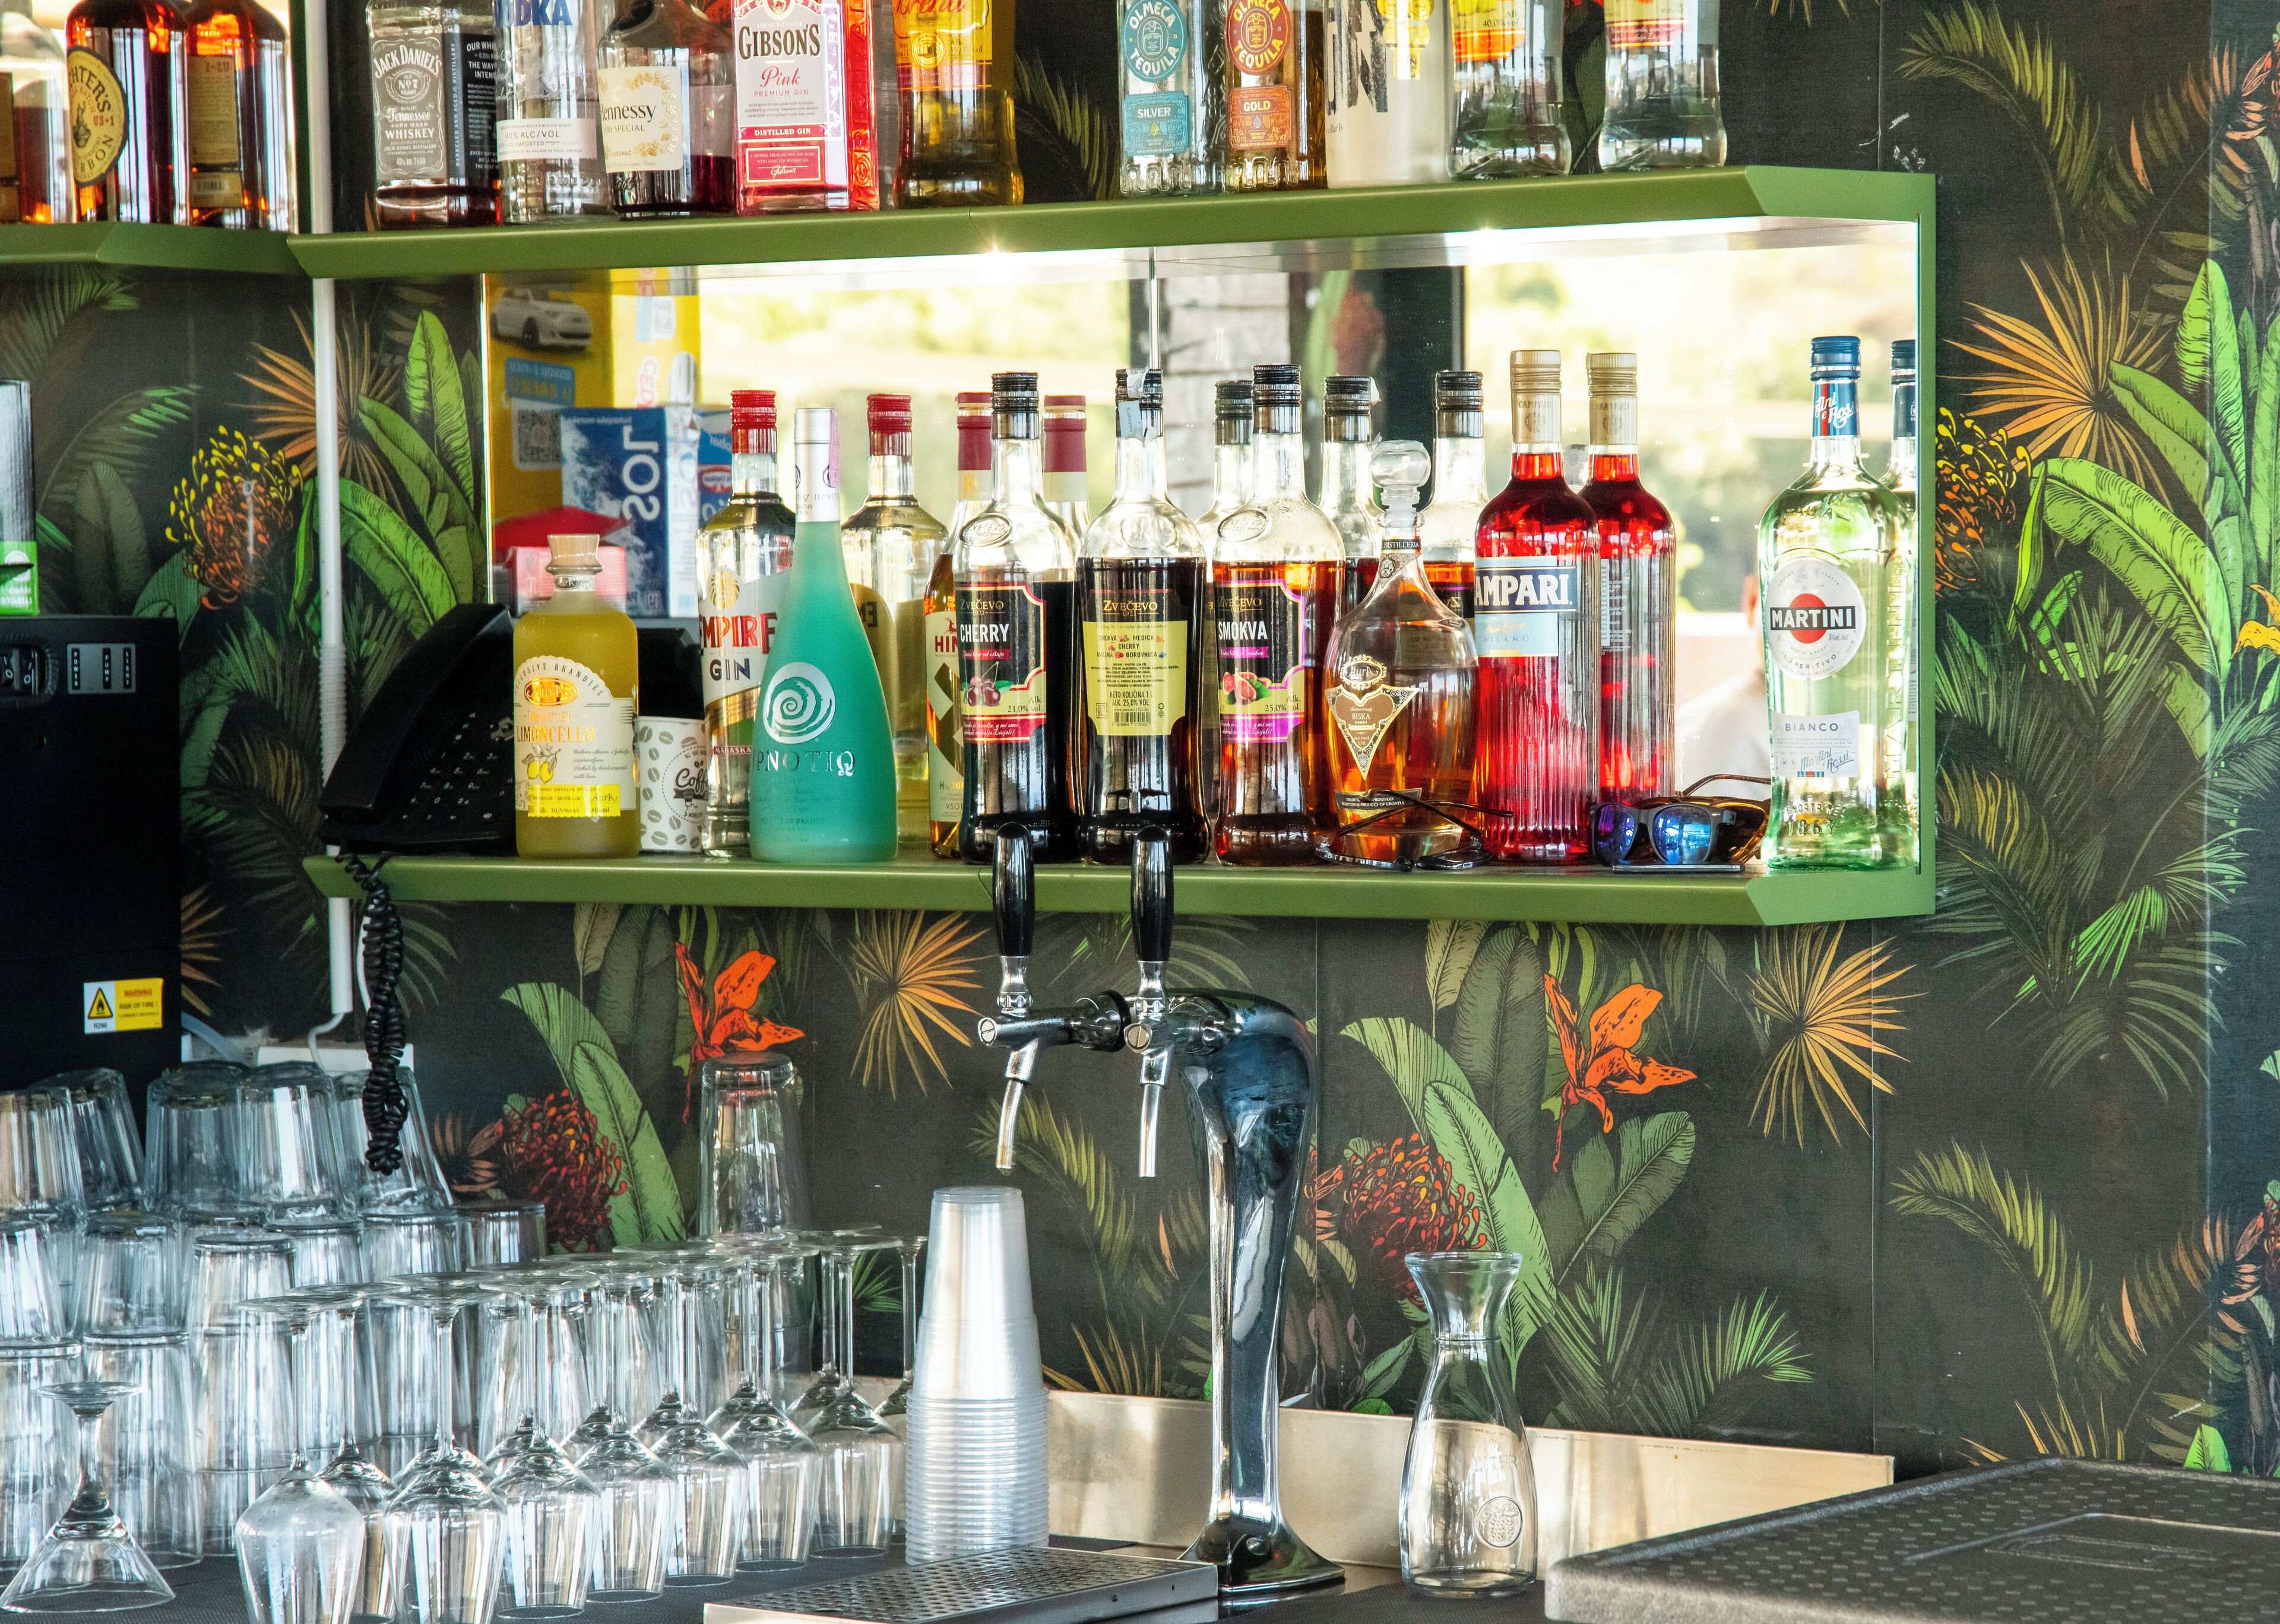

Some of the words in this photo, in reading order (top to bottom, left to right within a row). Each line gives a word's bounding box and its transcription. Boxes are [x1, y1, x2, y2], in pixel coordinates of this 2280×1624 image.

[1129, 1, 1176, 29] OLMECA
[1234, 0, 1281, 21] OLMECA
[1483, 19, 1506, 28] 40,0%
[467, 42, 480, 51] OUR
[739, 24, 821, 60] GIBSON'S
[373, 50, 400, 78] JACK
[400, 45, 442, 77] DANIEL'S
[1130, 46, 1179, 76] TEQUILA
[1234, 39, 1283, 69] TEQUILA
[760, 66, 801, 87] Pink
[1138, 106, 1171, 119] SILVER
[1243, 100, 1271, 112] GOLD
[387, 107, 431, 122] Tennessee
[385, 128, 434, 139] WHISKEY
[1519, 400, 1551, 408] CAMPARI
[961, 599, 1004, 611] ZVEČEVO
[1103, 599, 1158, 611] ZVEČEVO
[1218, 596, 1263, 607] ZVEČEVO
[1772, 608, 1852, 628] MARTINI
[960, 624, 1009, 642] CHERRY
[1218, 620, 1268, 640] SMOKVA
[710, 658, 751, 681] GIN
[554, 663, 603, 697] BRANDIES
[1122, 689, 1145, 698] KOLIČINA
[1008, 705, 1028, 713] 21,0%
[1123, 699, 1138, 707] 25,0%
[1265, 704, 1287, 712] 25,0%
[517, 725, 595, 743] LIMONCELLO
[1785, 722, 1839, 732] BIANCO
[1827, 750, 1854, 773] Rossi
[674, 767, 709, 793] Coff
[124, 988, 152, 997] WARNING
